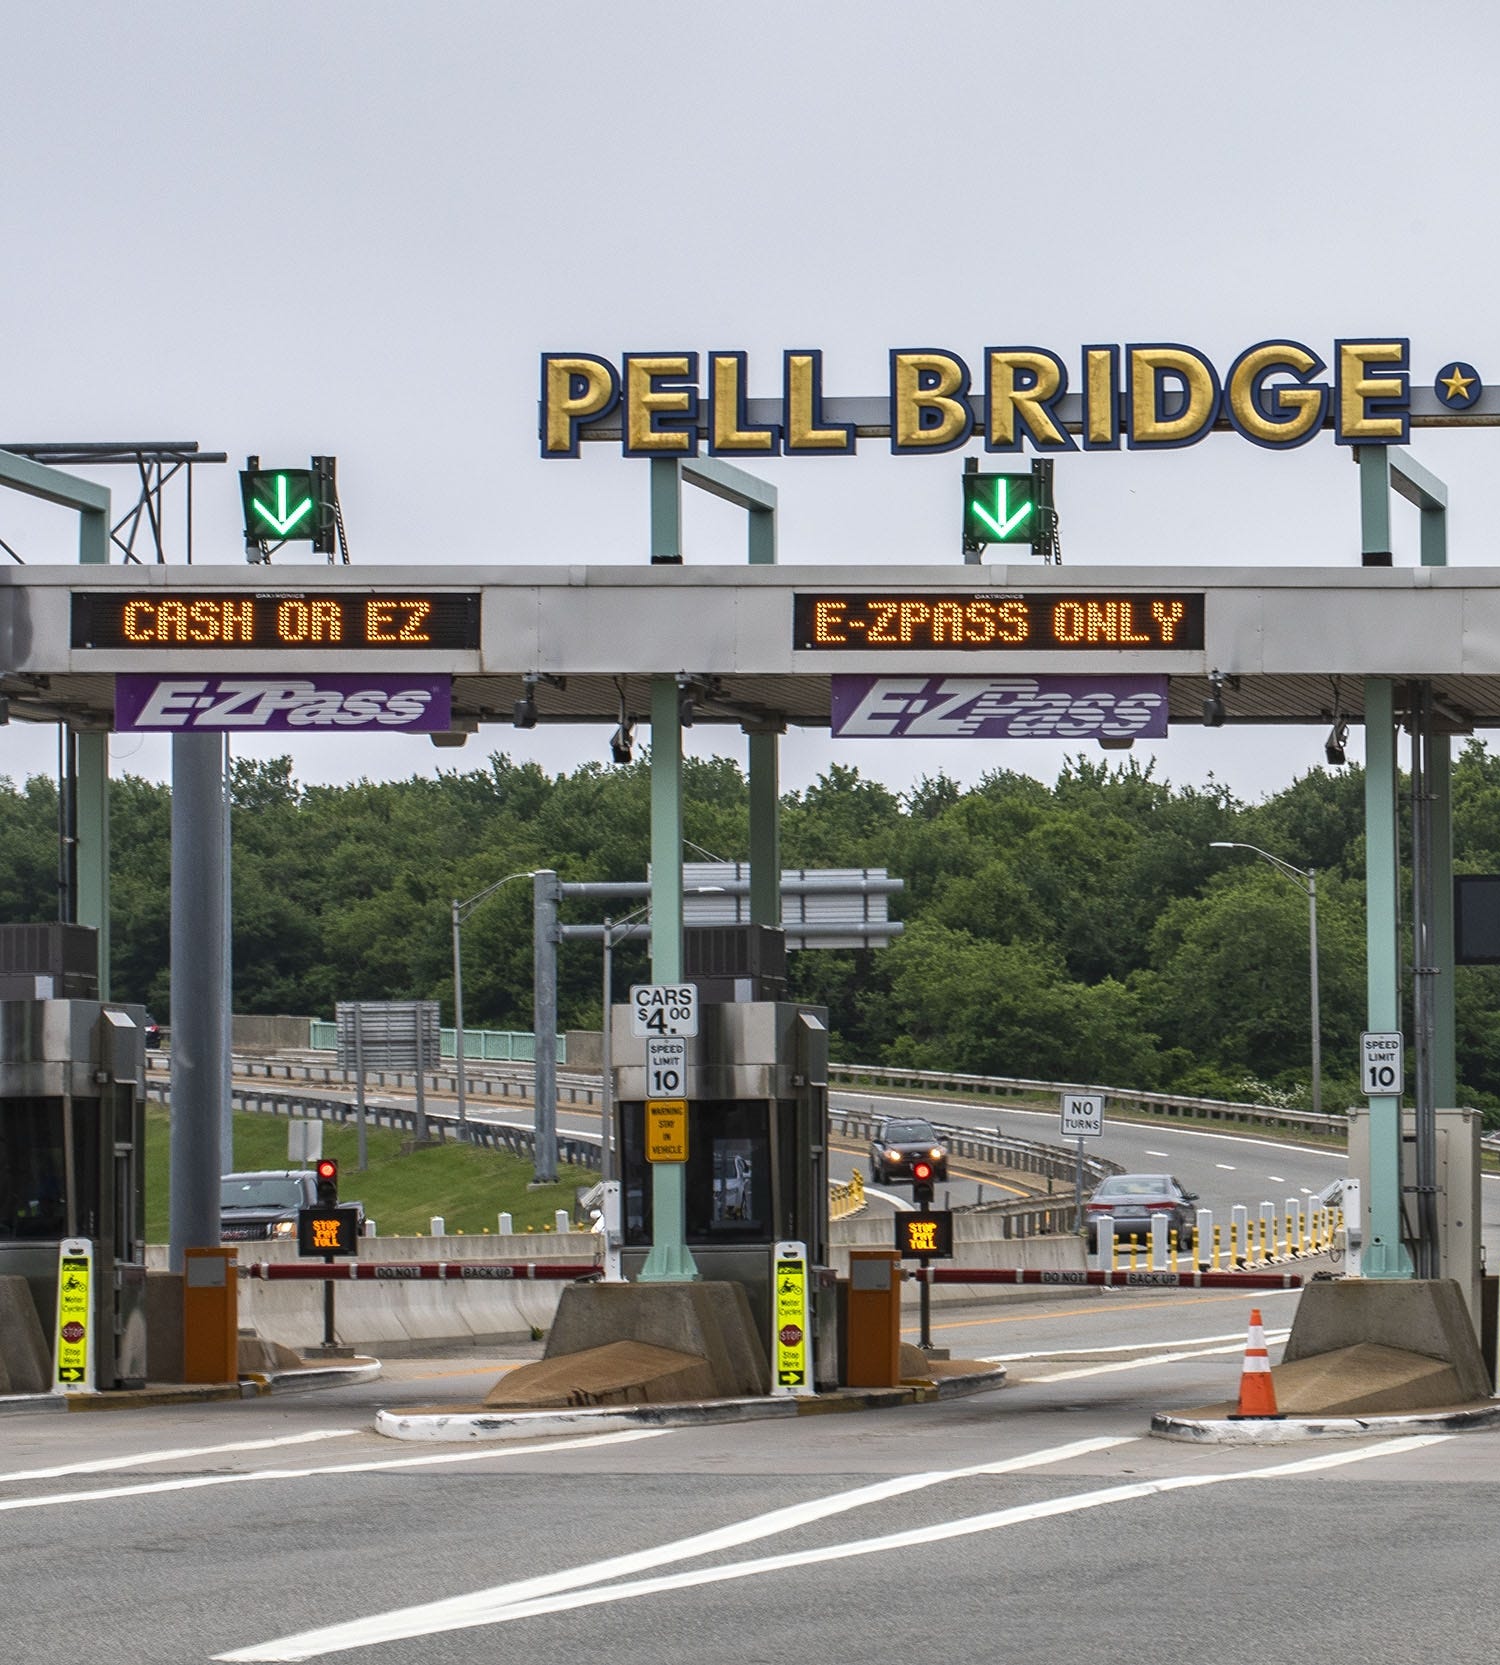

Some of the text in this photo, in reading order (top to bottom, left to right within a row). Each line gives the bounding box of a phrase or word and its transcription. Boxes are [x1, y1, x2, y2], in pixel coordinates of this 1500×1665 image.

[540, 349, 856, 458] PELL
[889, 337, 1412, 455] BRIDGE
[124, 601, 431, 641] CASH OR EZ
[815, 602, 1183, 642] E-ZPASS ONLY
[636, 988, 692, 1006] CARS
[651, 1045, 684, 1054] SPEED
[1365, 1041, 1399, 1049] SPEED
[653, 1057, 680, 1066] LIMIT
[1368, 1053, 1395, 1061] LIMIT
[654, 1070, 679, 1091] 10
[1369, 1066, 1395, 1087] 10
[651, 1107, 683, 1116] WARNING
[1071, 1102, 1093, 1116] NO
[658, 1120, 675, 1129] STAY
[1065, 1119, 1099, 1130] TURNS
[662, 1133, 671, 1141] IN
[652, 1146, 682, 1154] VEHICLE
[312, 1220, 340, 1231] STOP
[908, 1222, 937, 1233] STOP
[316, 1230, 338, 1239] PAY
[912, 1232, 934, 1240] PAY
[314, 1238, 340, 1247] TOLL
[909, 1239, 937, 1249] TOLL
[378, 1267, 511, 1277] DO NOT BACK UP
[1043, 1273, 1176, 1284] DO NOT BACK UP
[62, 1305, 87, 1313] Cycles
[779, 1308, 801, 1316] Cycles
[62, 1327, 84, 1337] STOP
[780, 1331, 803, 1341] STOP
[65, 1349, 80, 1357] Stop
[783, 1351, 799, 1360] Stop
